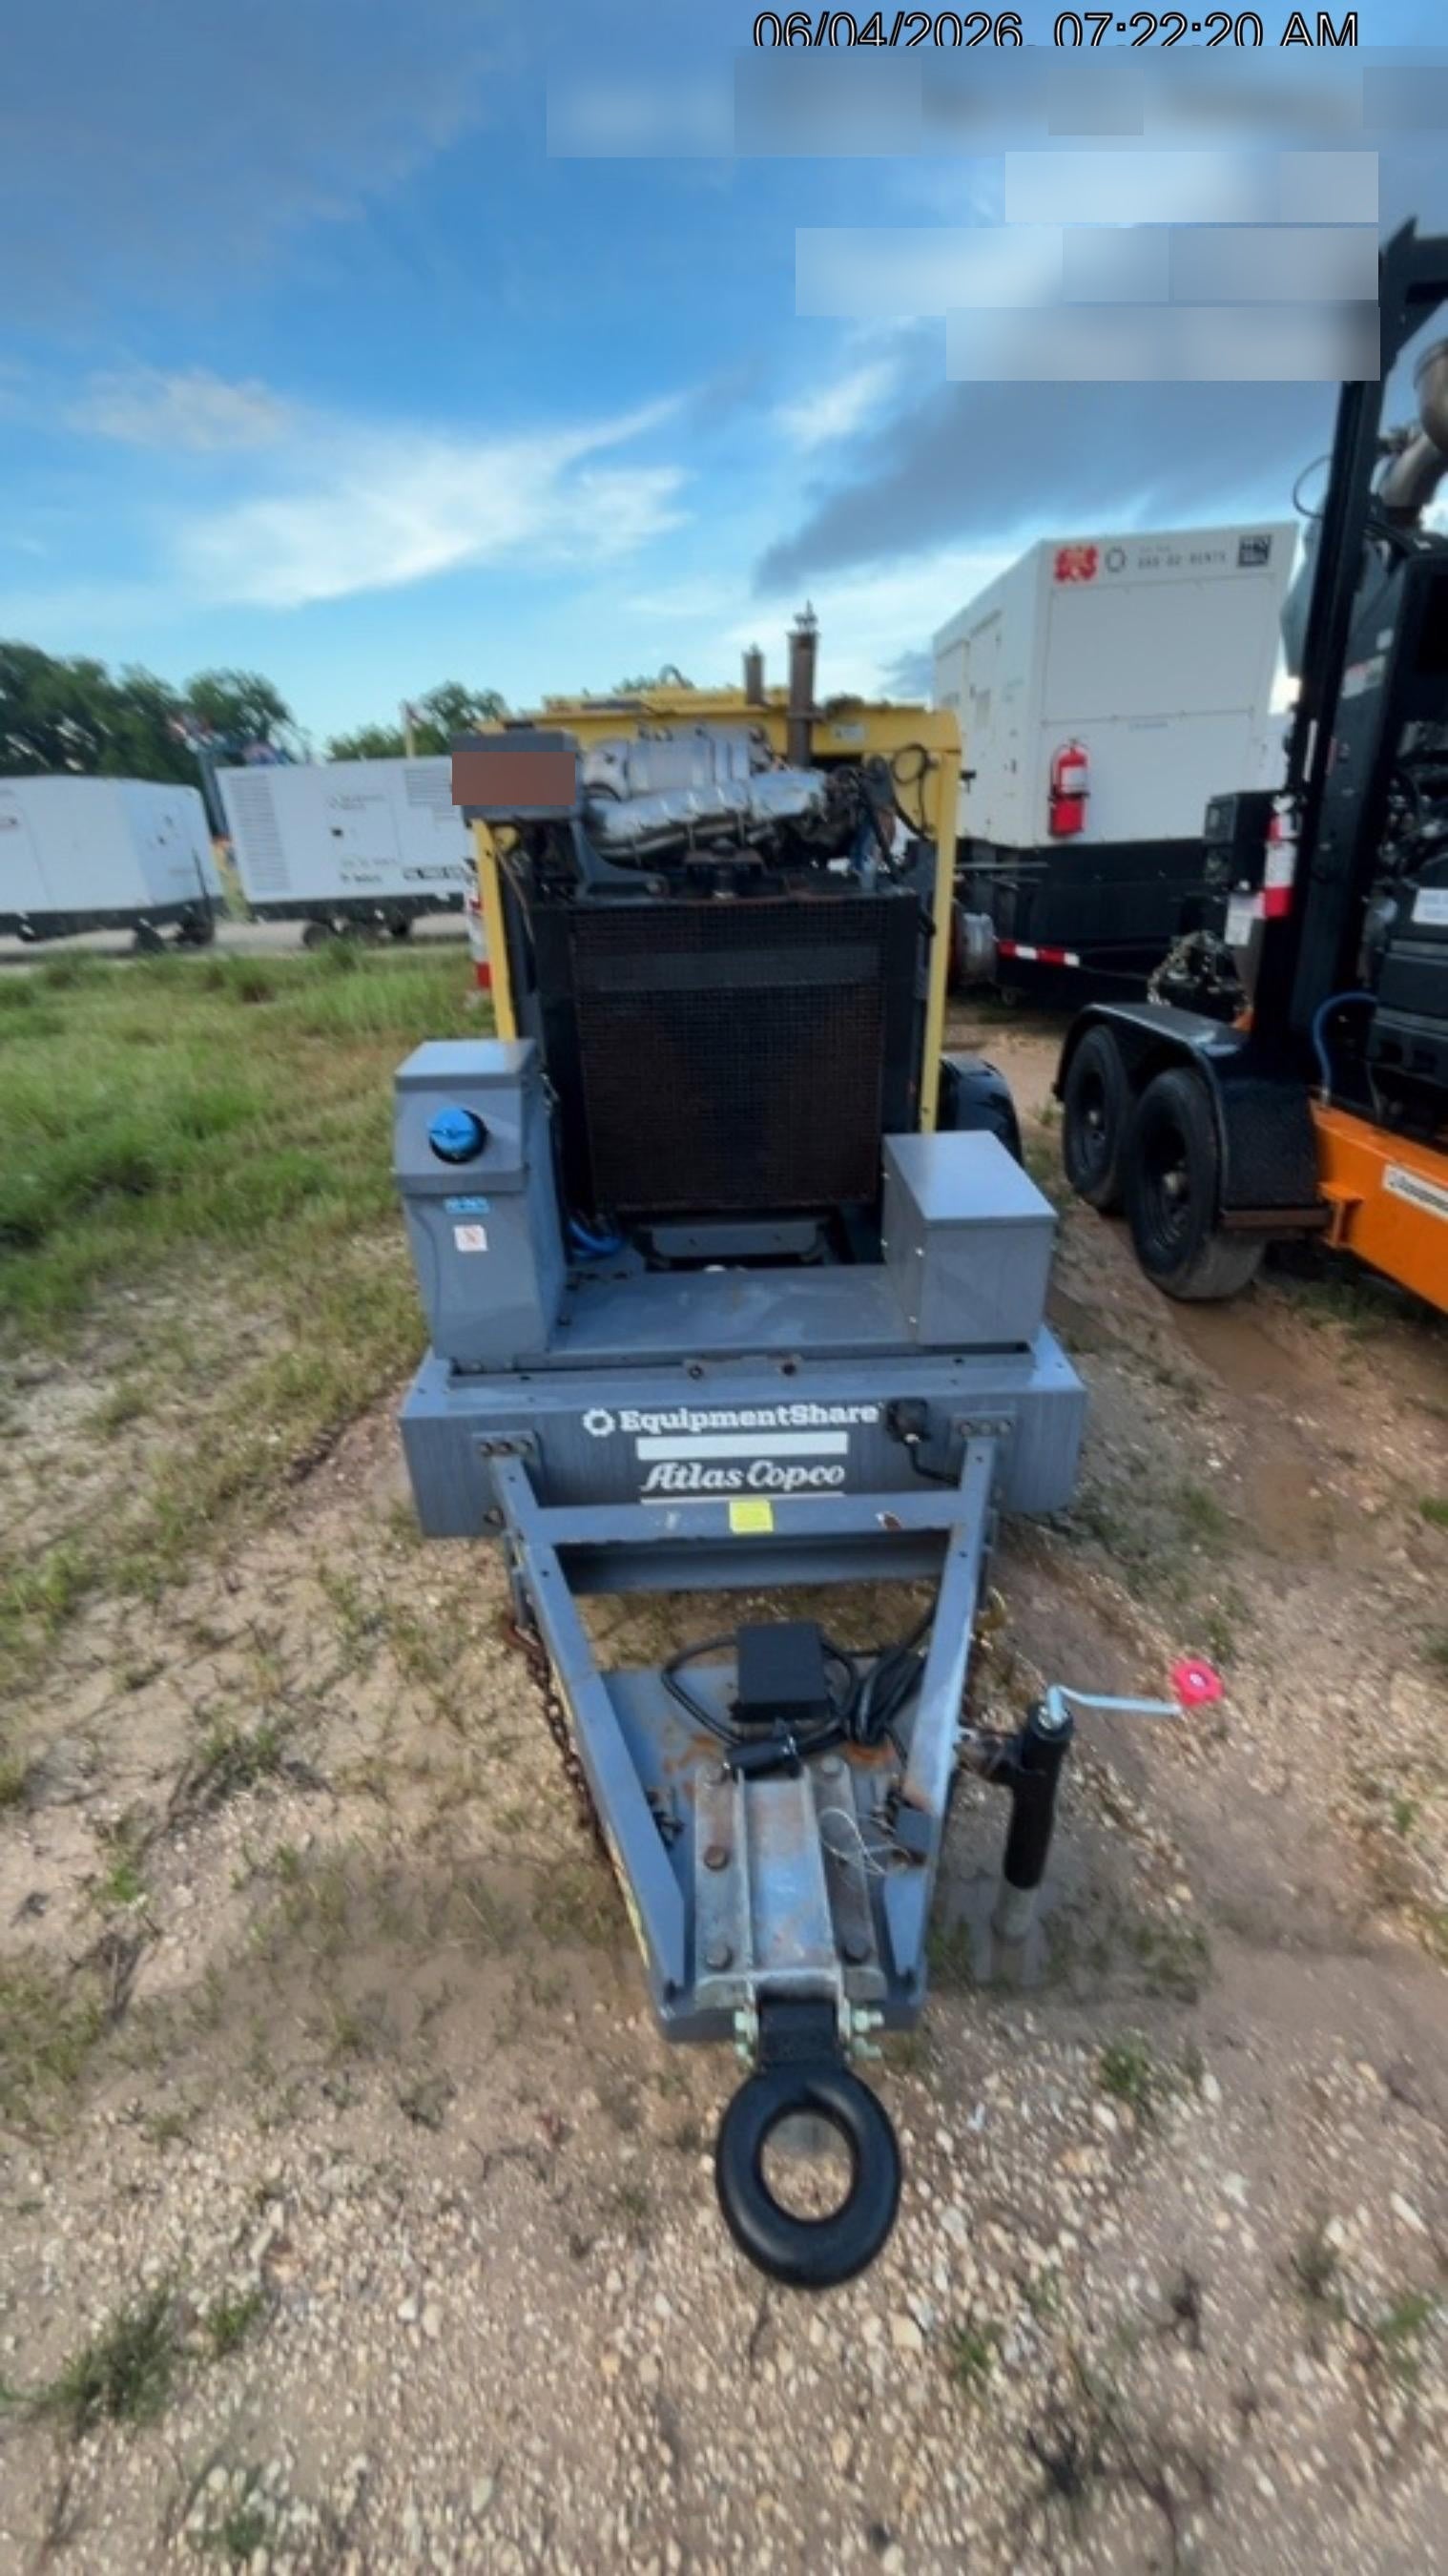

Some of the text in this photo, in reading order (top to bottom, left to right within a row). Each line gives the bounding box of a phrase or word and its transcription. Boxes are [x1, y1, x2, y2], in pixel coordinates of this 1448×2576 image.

[619, 1402, 879, 1434] EquipmentShare
[639, 1459, 845, 1491] Atlas Copco
